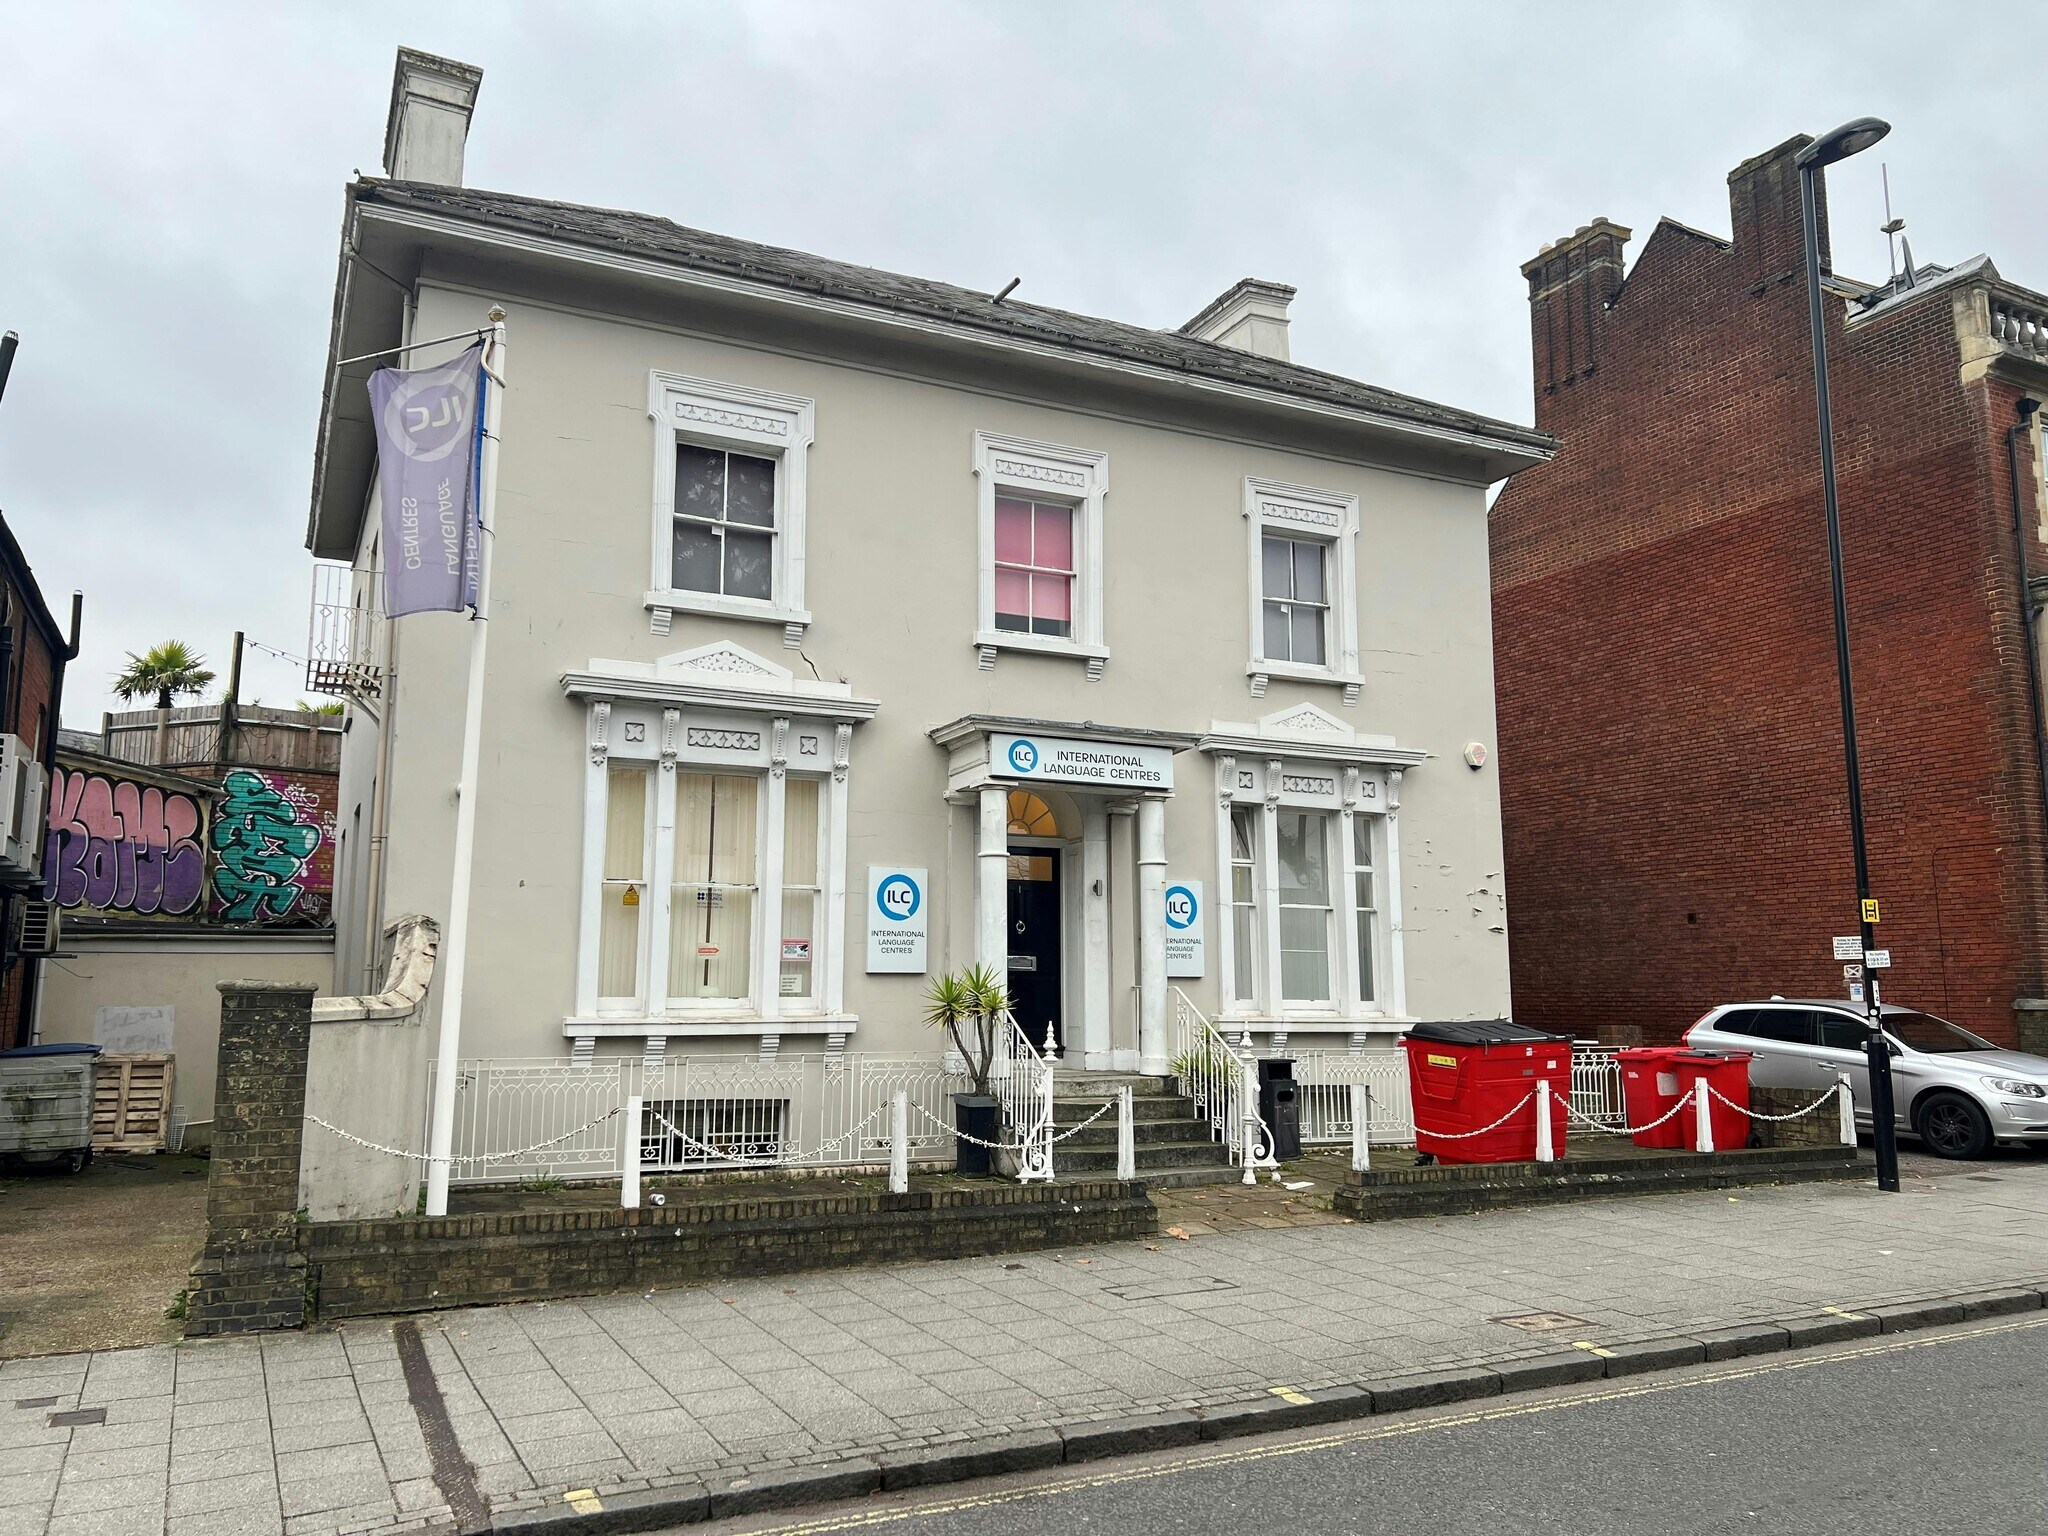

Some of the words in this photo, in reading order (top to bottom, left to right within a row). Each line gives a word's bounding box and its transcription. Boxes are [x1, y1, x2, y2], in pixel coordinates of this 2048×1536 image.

[1015, 751, 1032, 762] ILC
[1057, 751, 1144, 767] INTERNATIONAL
[1044, 763, 1105, 778] LANGUAGE
[1110, 768, 1161, 782] CENTRES
[887, 889, 911, 904] ILC
[1169, 901, 1188, 914] ILC
[871, 930, 925, 938] INTERNATIONAL
